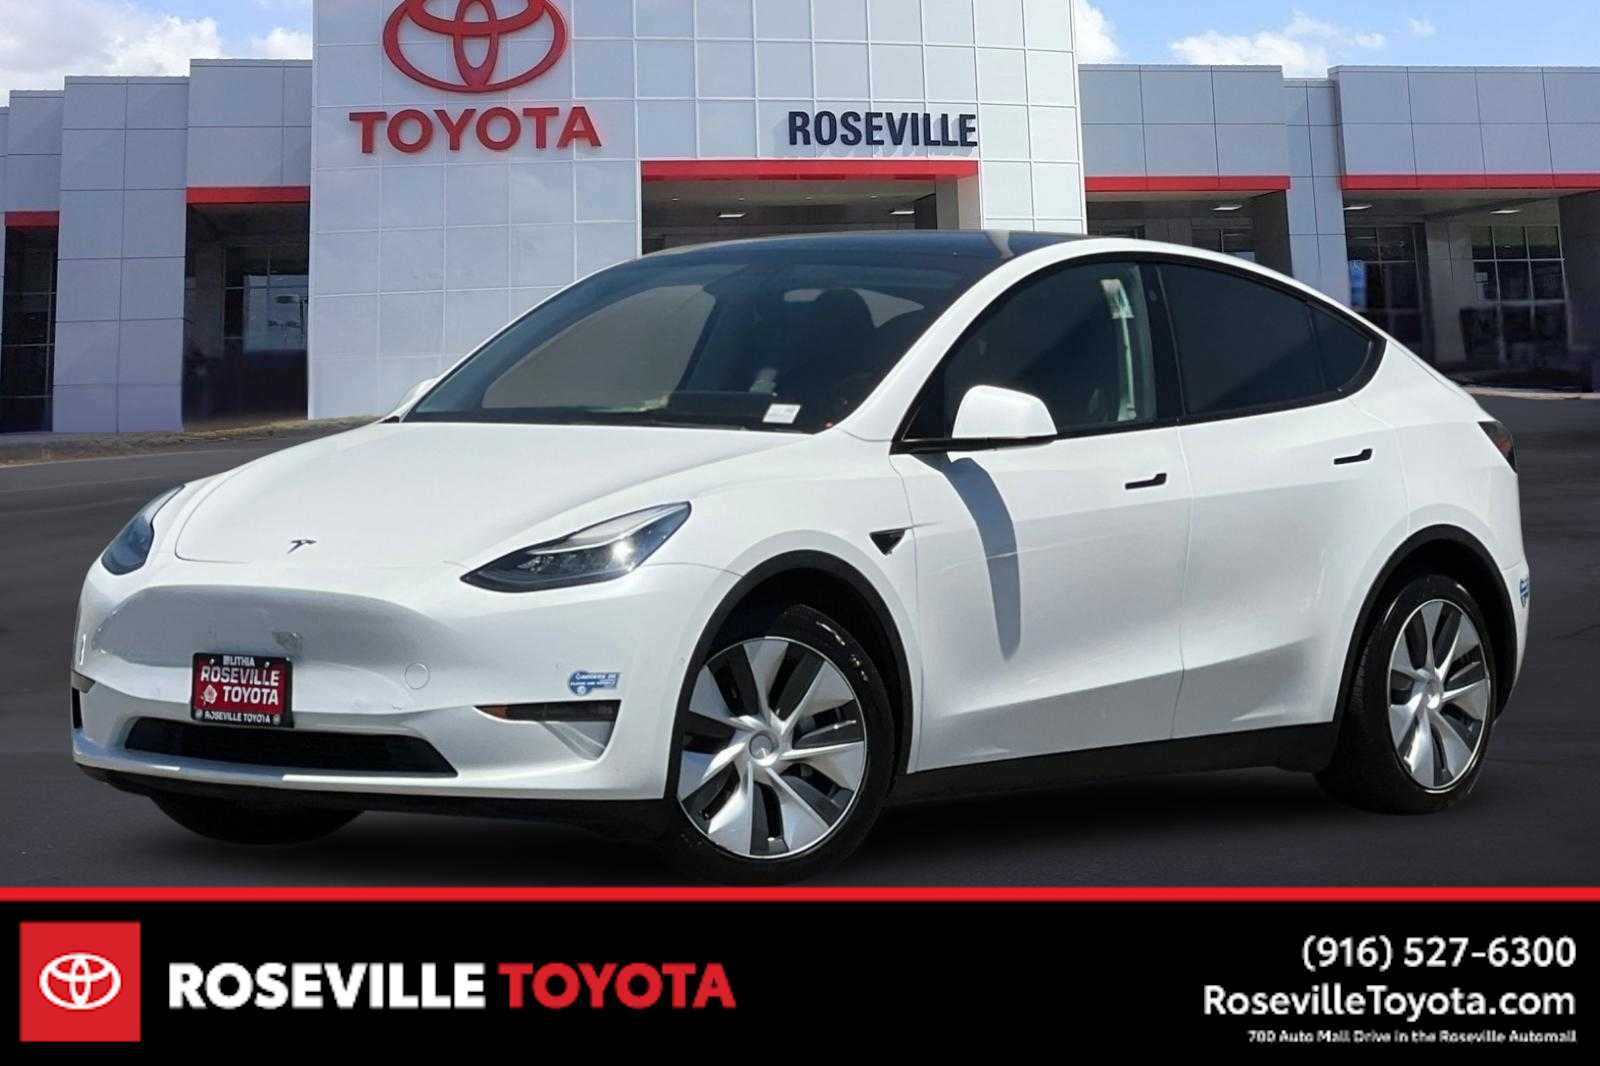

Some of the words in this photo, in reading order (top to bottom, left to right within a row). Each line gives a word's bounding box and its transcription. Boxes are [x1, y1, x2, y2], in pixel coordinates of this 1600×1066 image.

[349, 106, 602, 154] TOYOTA
[788, 110, 979, 147] ROSEVILLE
[200, 665, 281, 687] ROSEVILLE
[222, 686, 279, 706] TOYOTA
[204, 710, 242, 722] ROSEVILLE
[243, 713, 271, 724] TOYOTA
